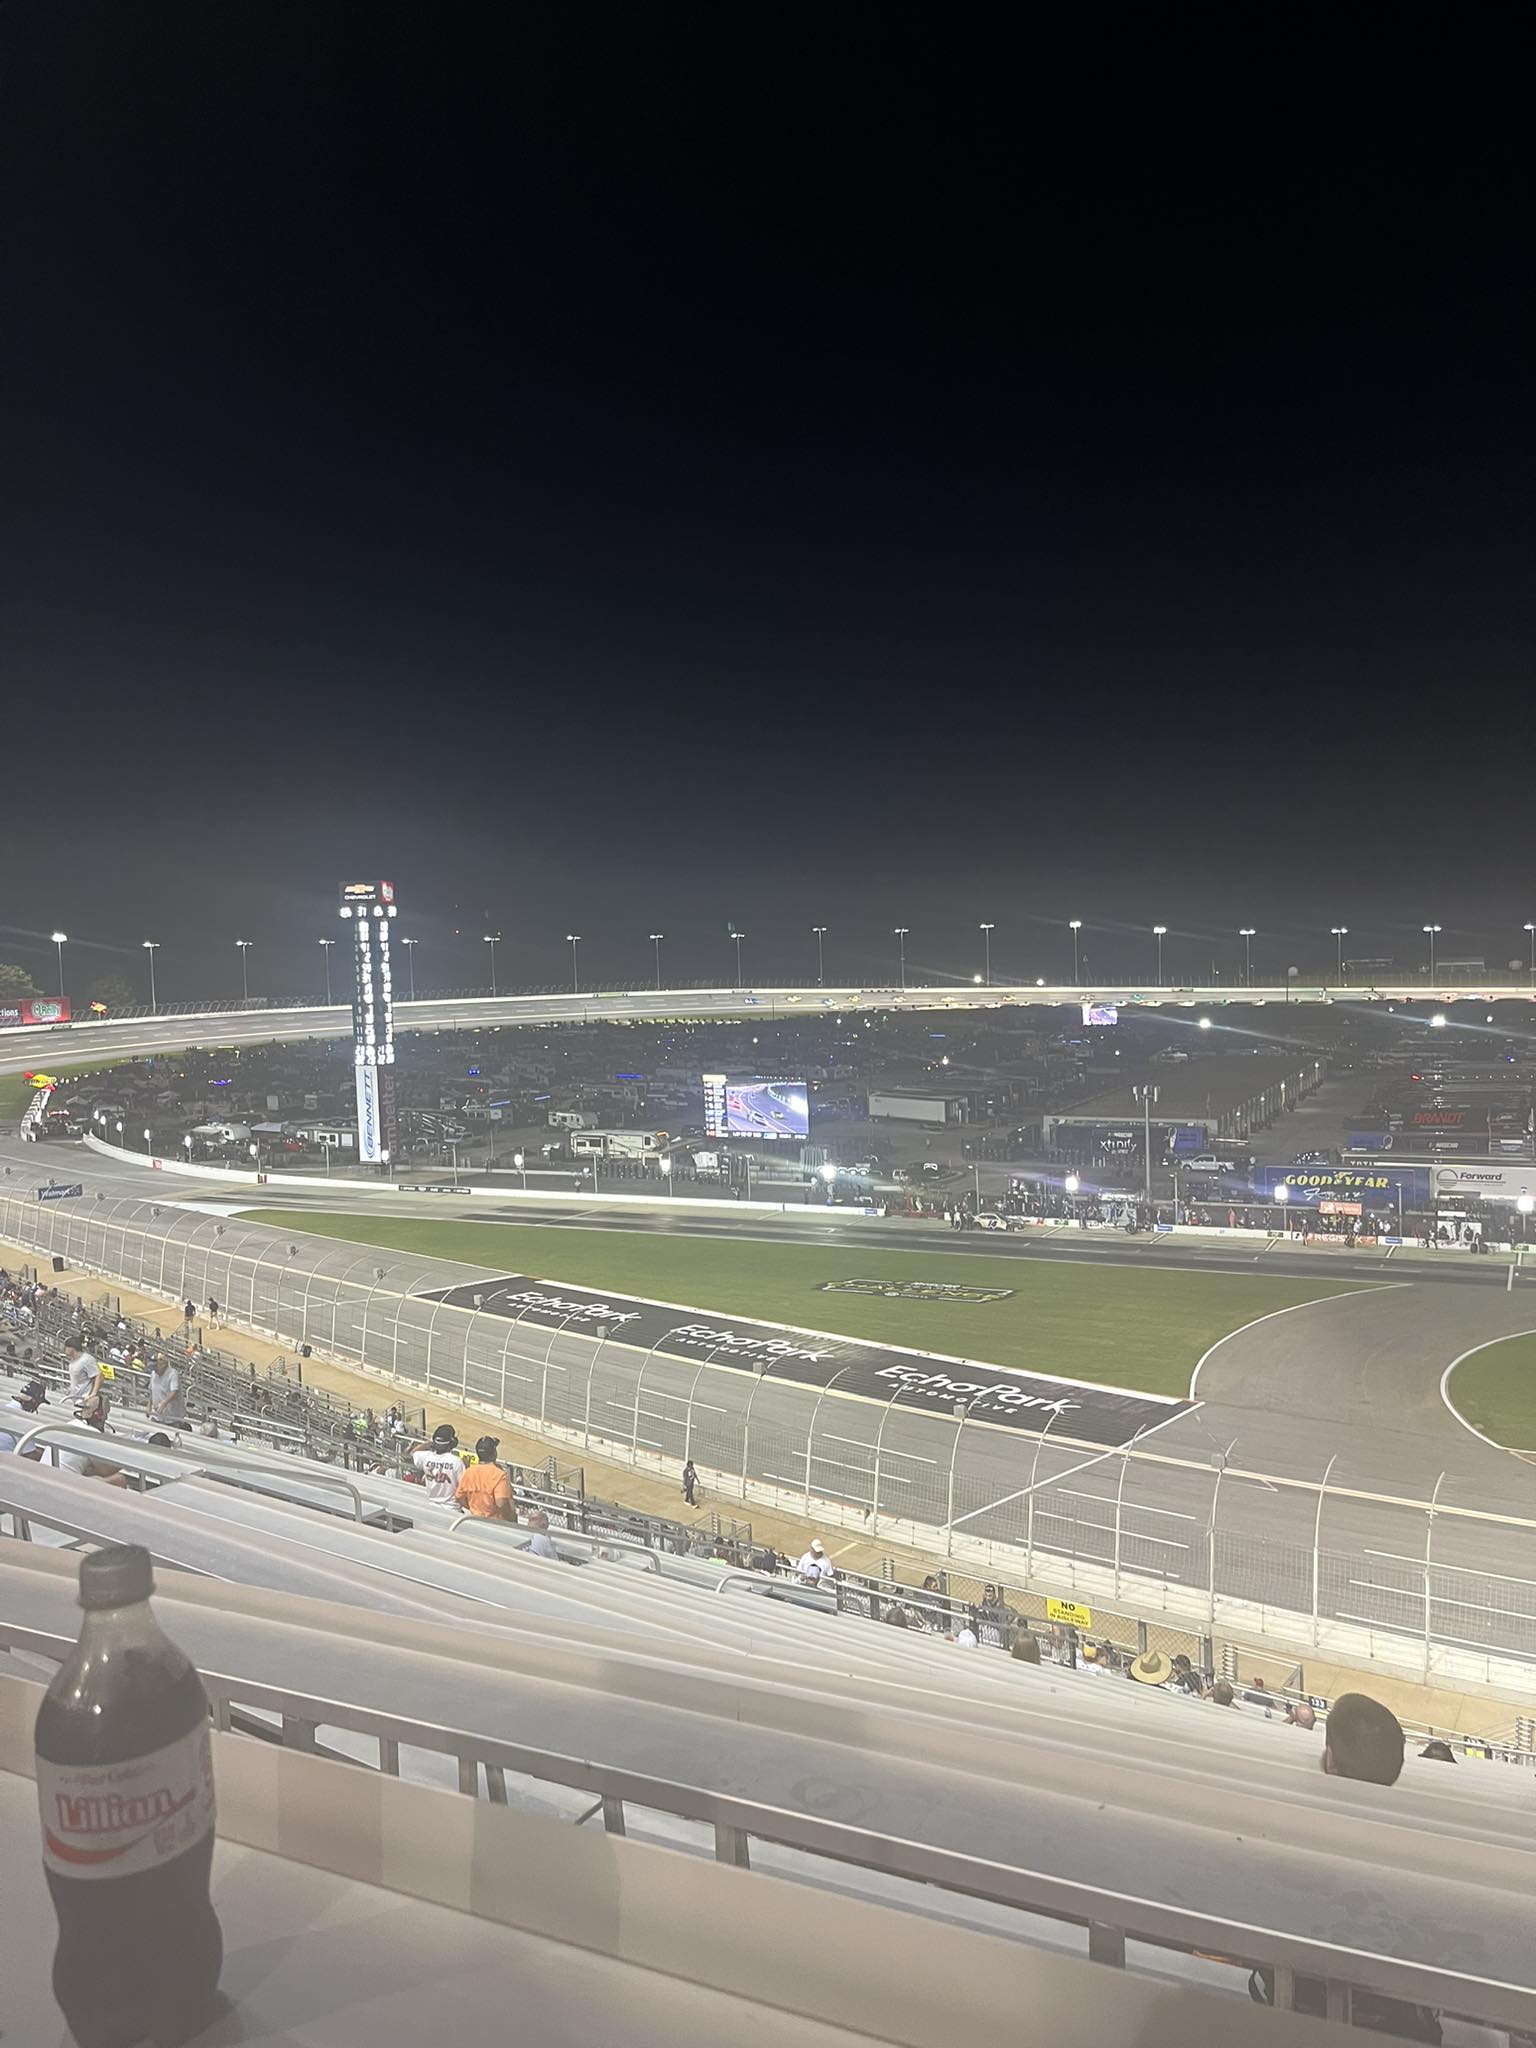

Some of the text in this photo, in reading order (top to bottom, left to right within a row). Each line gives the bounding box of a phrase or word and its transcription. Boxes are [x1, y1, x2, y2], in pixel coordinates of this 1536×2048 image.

[1459, 1172, 1503, 1181] Forward
[987, 1219, 998, 1228] 14
[506, 1291, 643, 1322] EchoPark
[670, 1324, 835, 1362] EchoPark
[874, 1365, 1082, 1415] EchoPark
[887, 1383, 1018, 1414] AUTOMOTIVE
[1053, 1608, 1086, 1620] STANDING
[1061, 1601, 1076, 1611] NO
